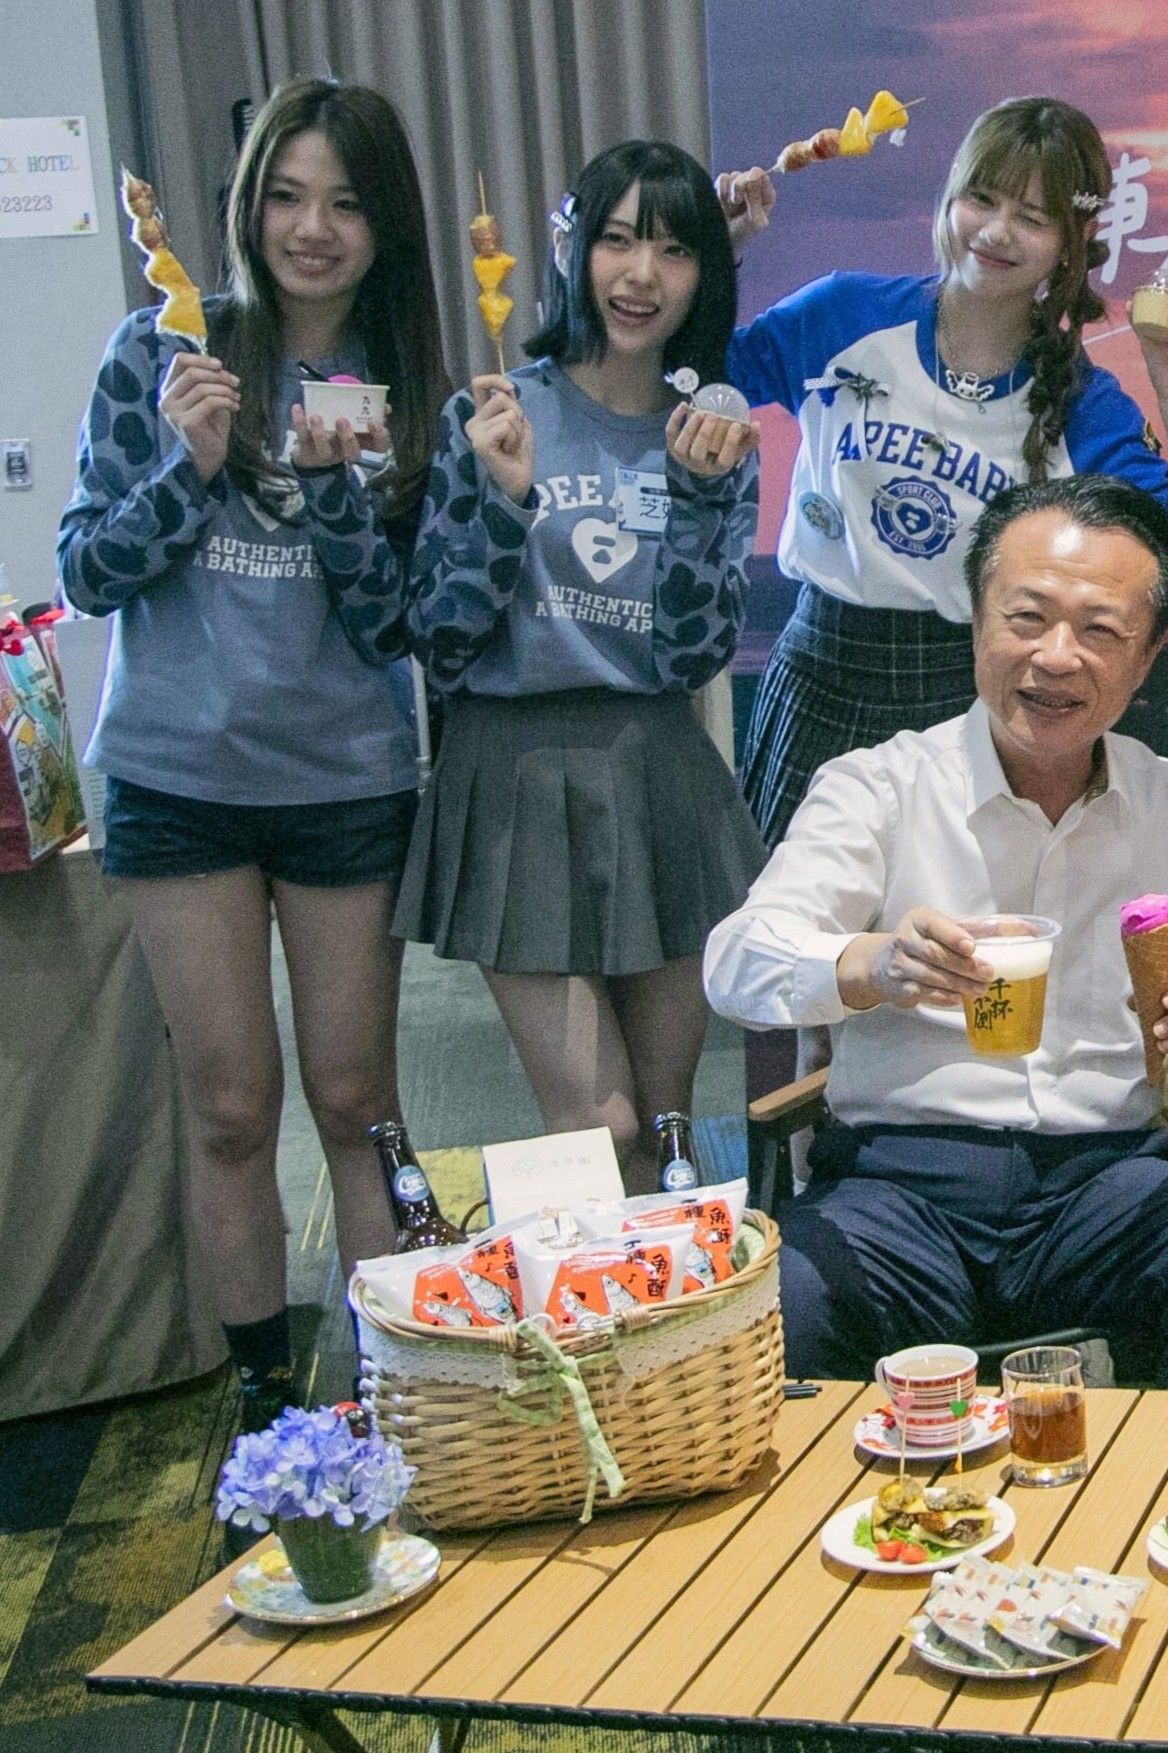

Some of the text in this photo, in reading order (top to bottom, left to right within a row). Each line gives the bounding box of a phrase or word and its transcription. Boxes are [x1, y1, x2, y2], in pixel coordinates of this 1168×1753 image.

[27, 154, 79, 172] HOTEL
[0, 194, 53, 213] 23223
[931, 439, 1016, 507] BAB
[207, 535, 317, 562] AUTHENTI
[207, 552, 296, 579] BATHING
[536, 601, 548, 617] A
[551, 601, 622, 628] BATHING
